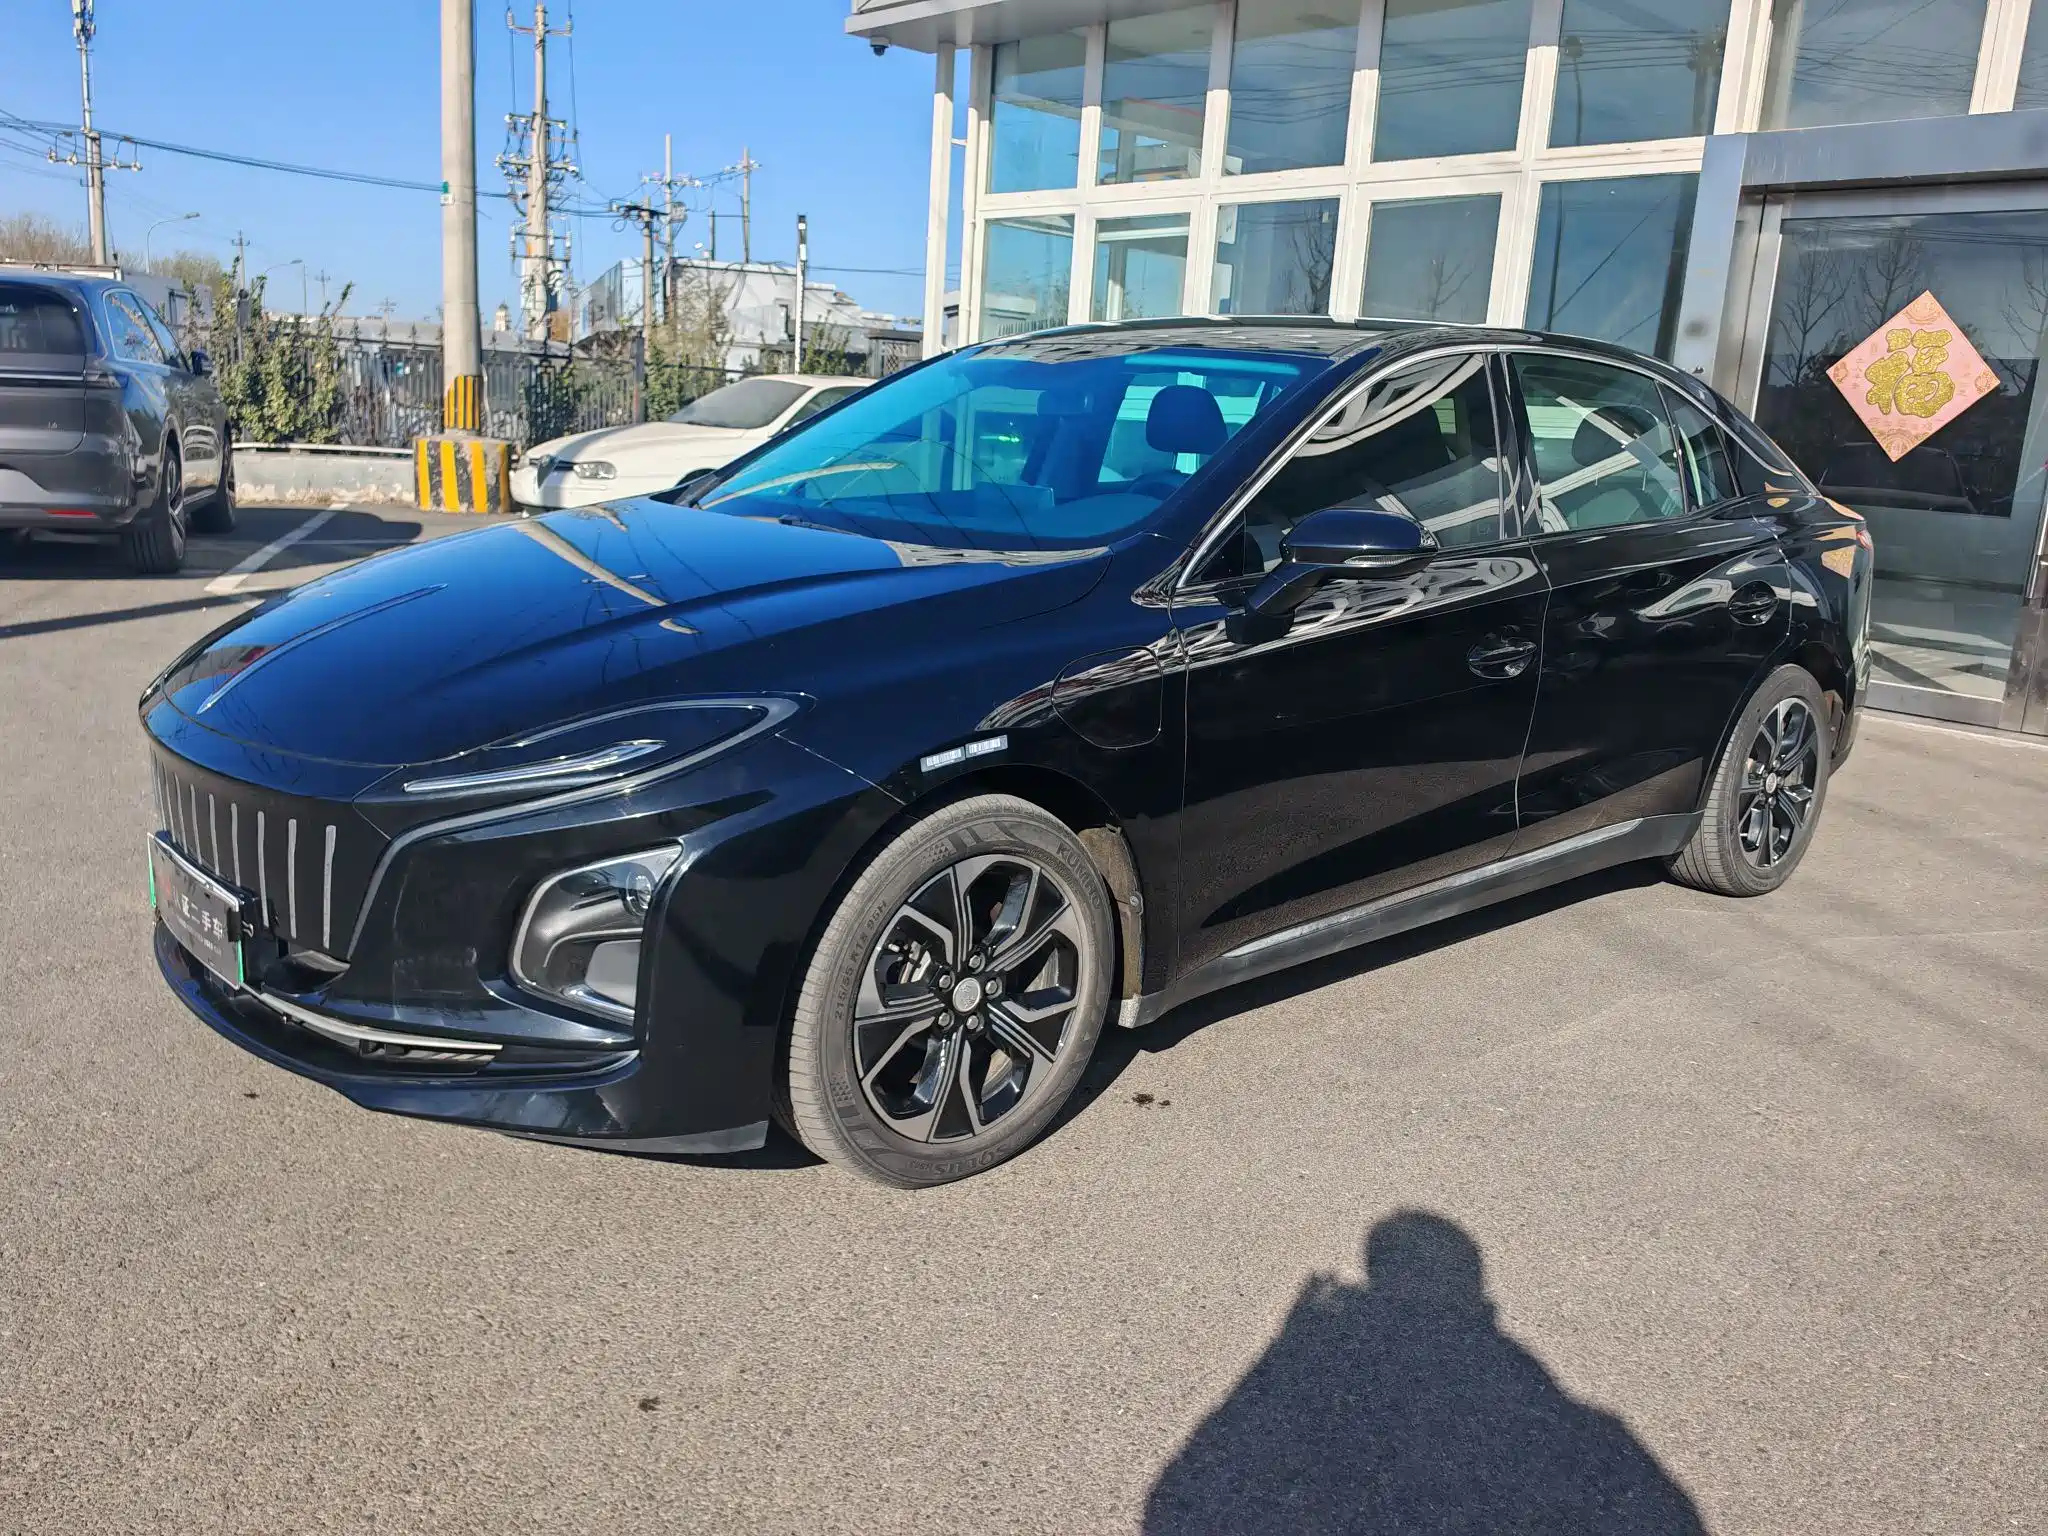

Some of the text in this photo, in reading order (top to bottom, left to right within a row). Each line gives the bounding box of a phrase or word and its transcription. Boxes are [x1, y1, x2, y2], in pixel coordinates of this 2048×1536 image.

[1864, 328, 1956, 418] 福
[1056, 842, 1101, 910] KUMHO
[834, 966, 854, 1020] 215/55
